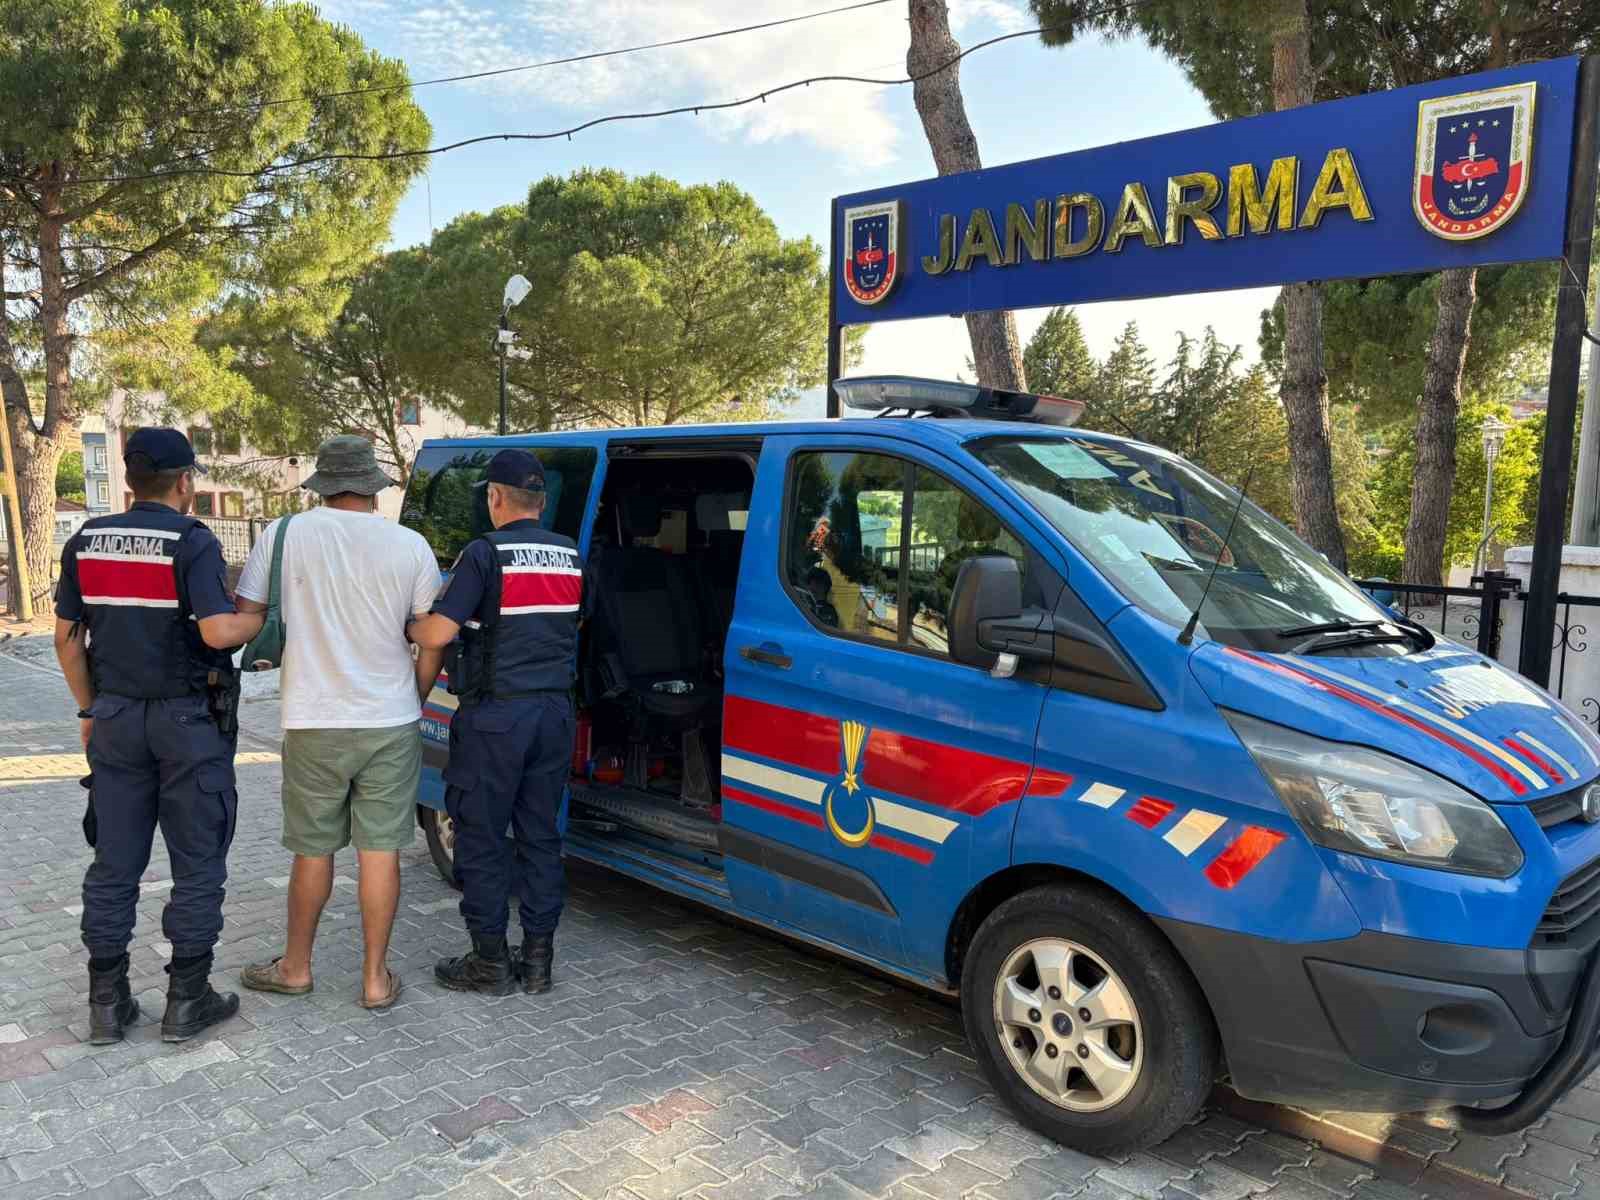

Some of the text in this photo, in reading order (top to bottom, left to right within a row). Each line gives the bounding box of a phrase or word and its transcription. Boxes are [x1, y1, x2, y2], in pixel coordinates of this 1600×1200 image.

[922, 147, 1374, 275] JANDARMA
[1423, 192, 1516, 232] JANDARMA
[85, 535, 164, 557] JANDARMA
[511, 549, 574, 569] JANDARMA
